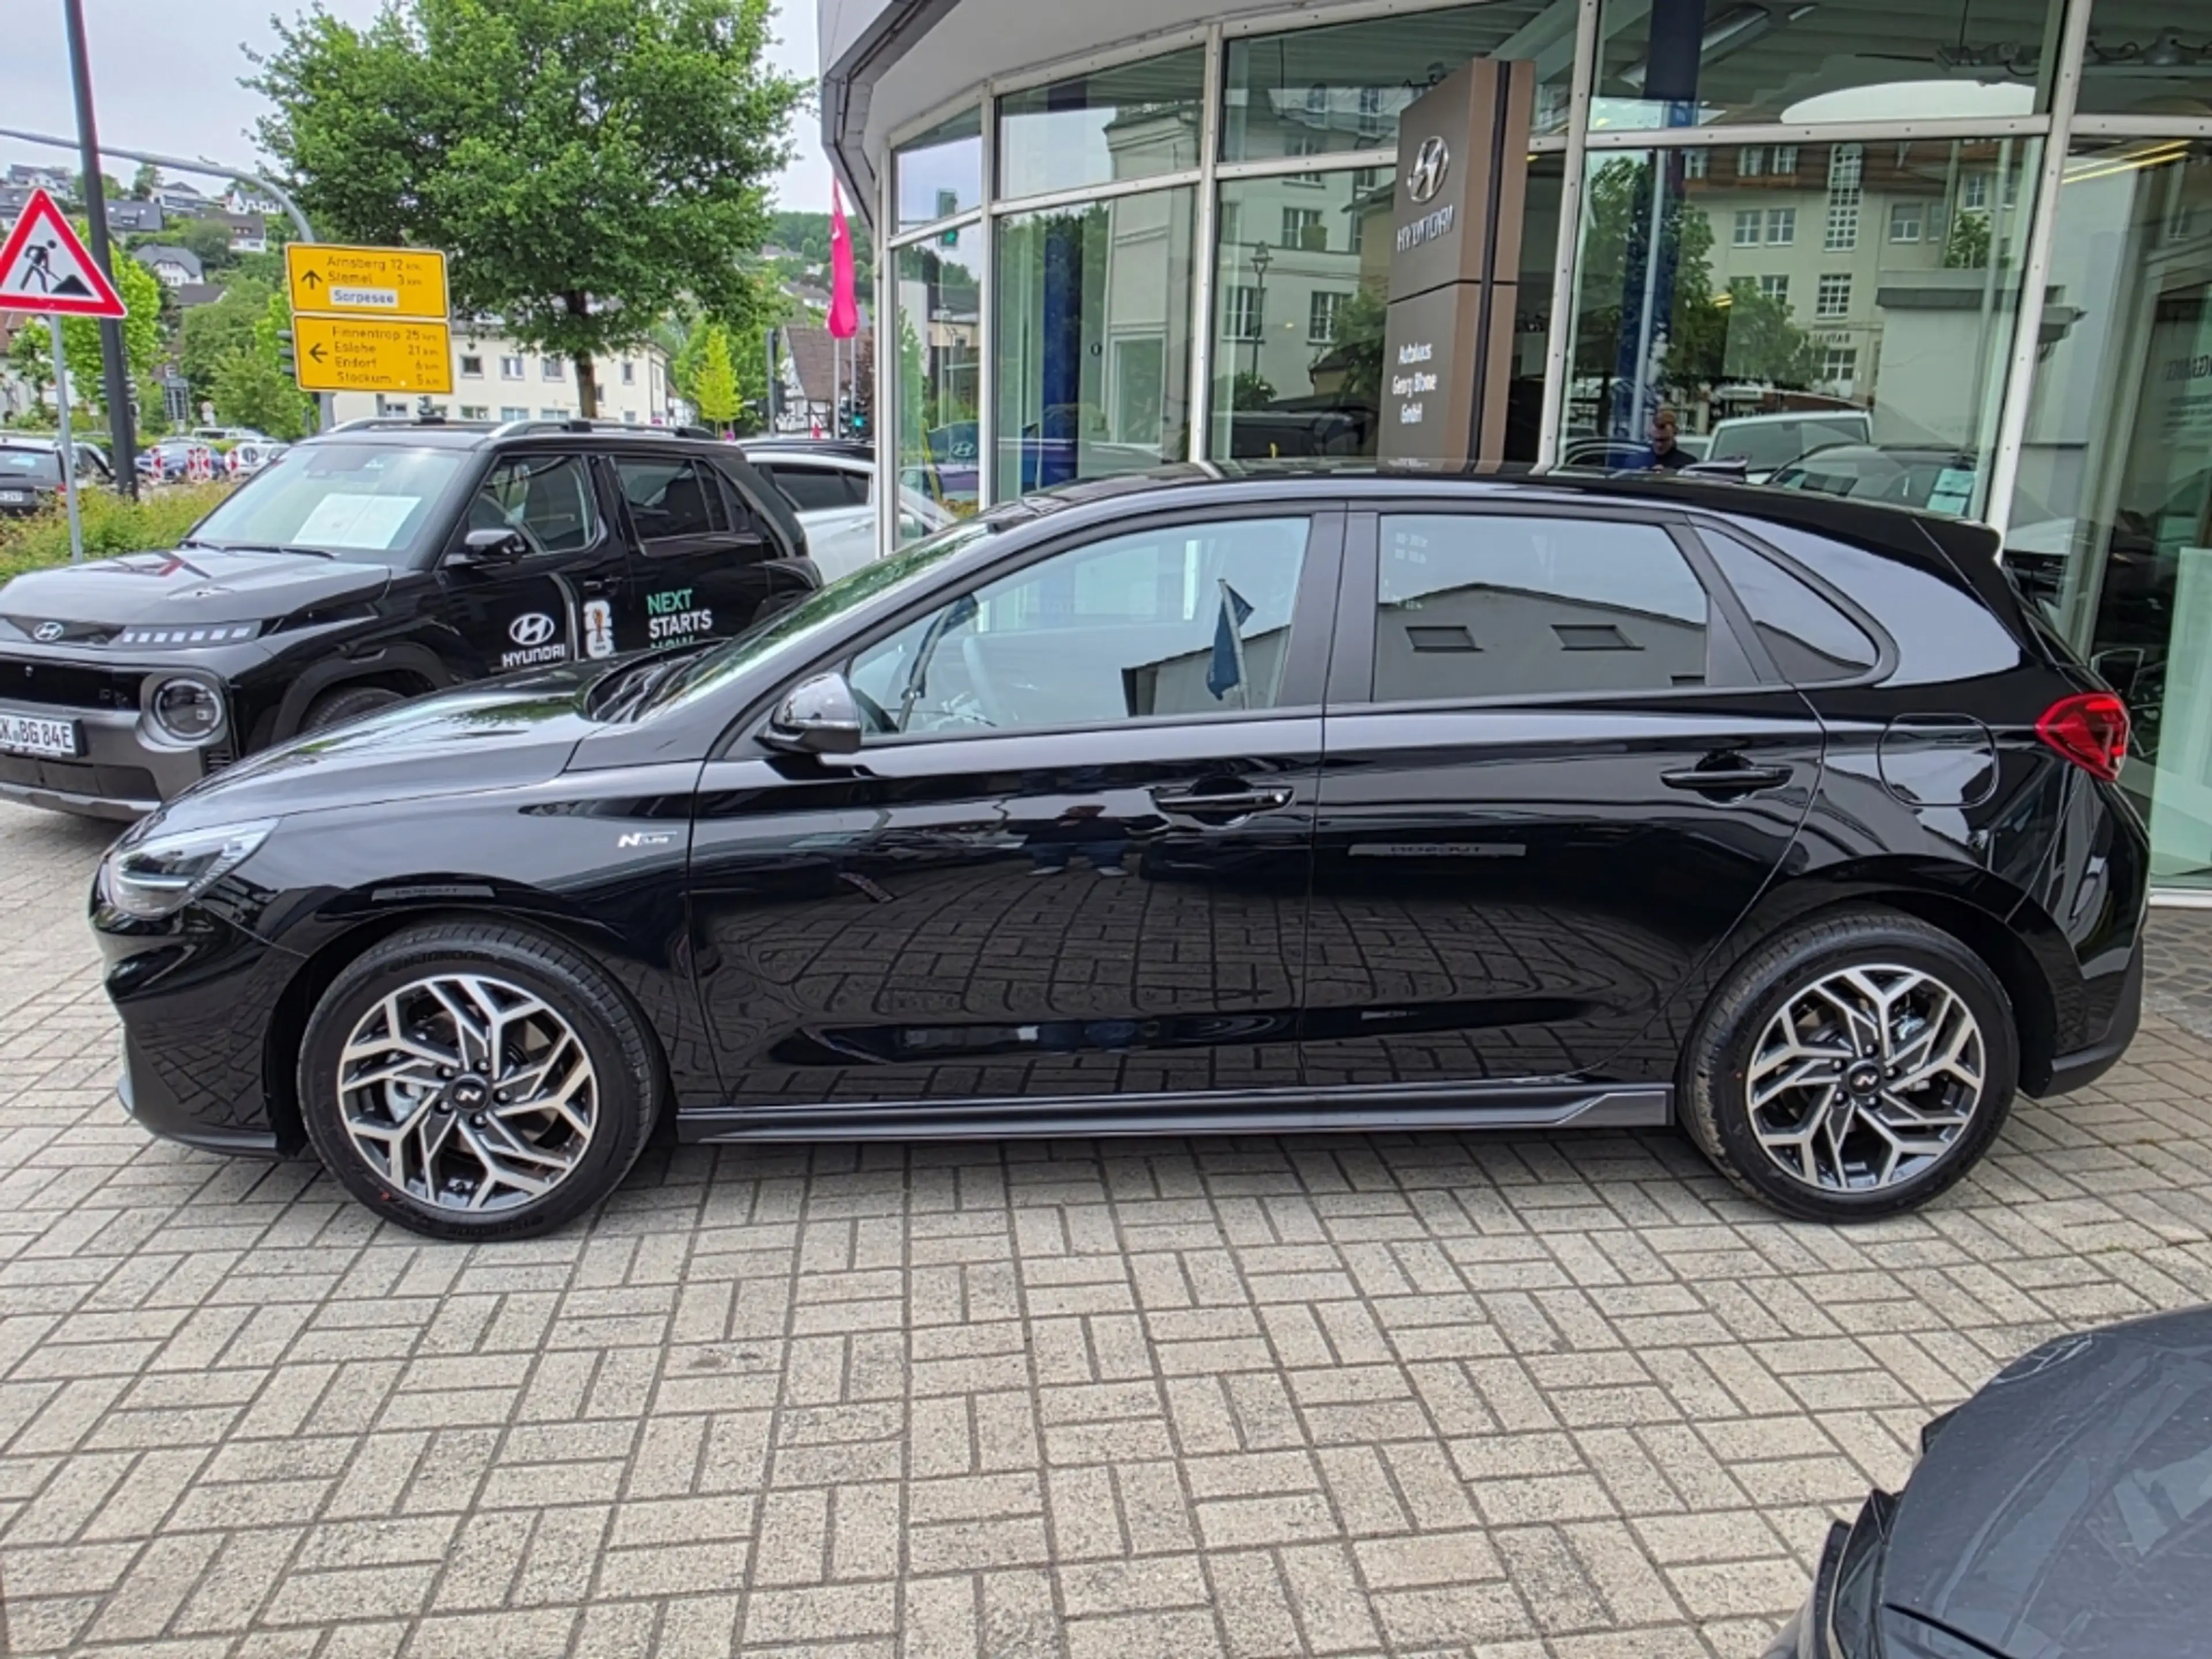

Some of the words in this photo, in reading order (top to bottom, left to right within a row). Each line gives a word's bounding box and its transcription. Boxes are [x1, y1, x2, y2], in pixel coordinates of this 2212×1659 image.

[1397, 203, 1453, 253] HYUNDAI
[327, 256, 385, 273] Arnsberg
[391, 259, 403, 271] 12
[334, 289, 394, 304] Sorpesee
[406, 329, 420, 341] 25
[408, 345, 421, 357] 21
[335, 357, 377, 369] Endorf
[337, 372, 392, 384] Stockum
[646, 588, 693, 615] NEXT
[649, 609, 713, 639] STARTS
[502, 643, 565, 668] HYUNDAI
[19, 719, 40, 744] BG
[41, 724, 72, 748] 84E
[617, 832, 642, 848] N
